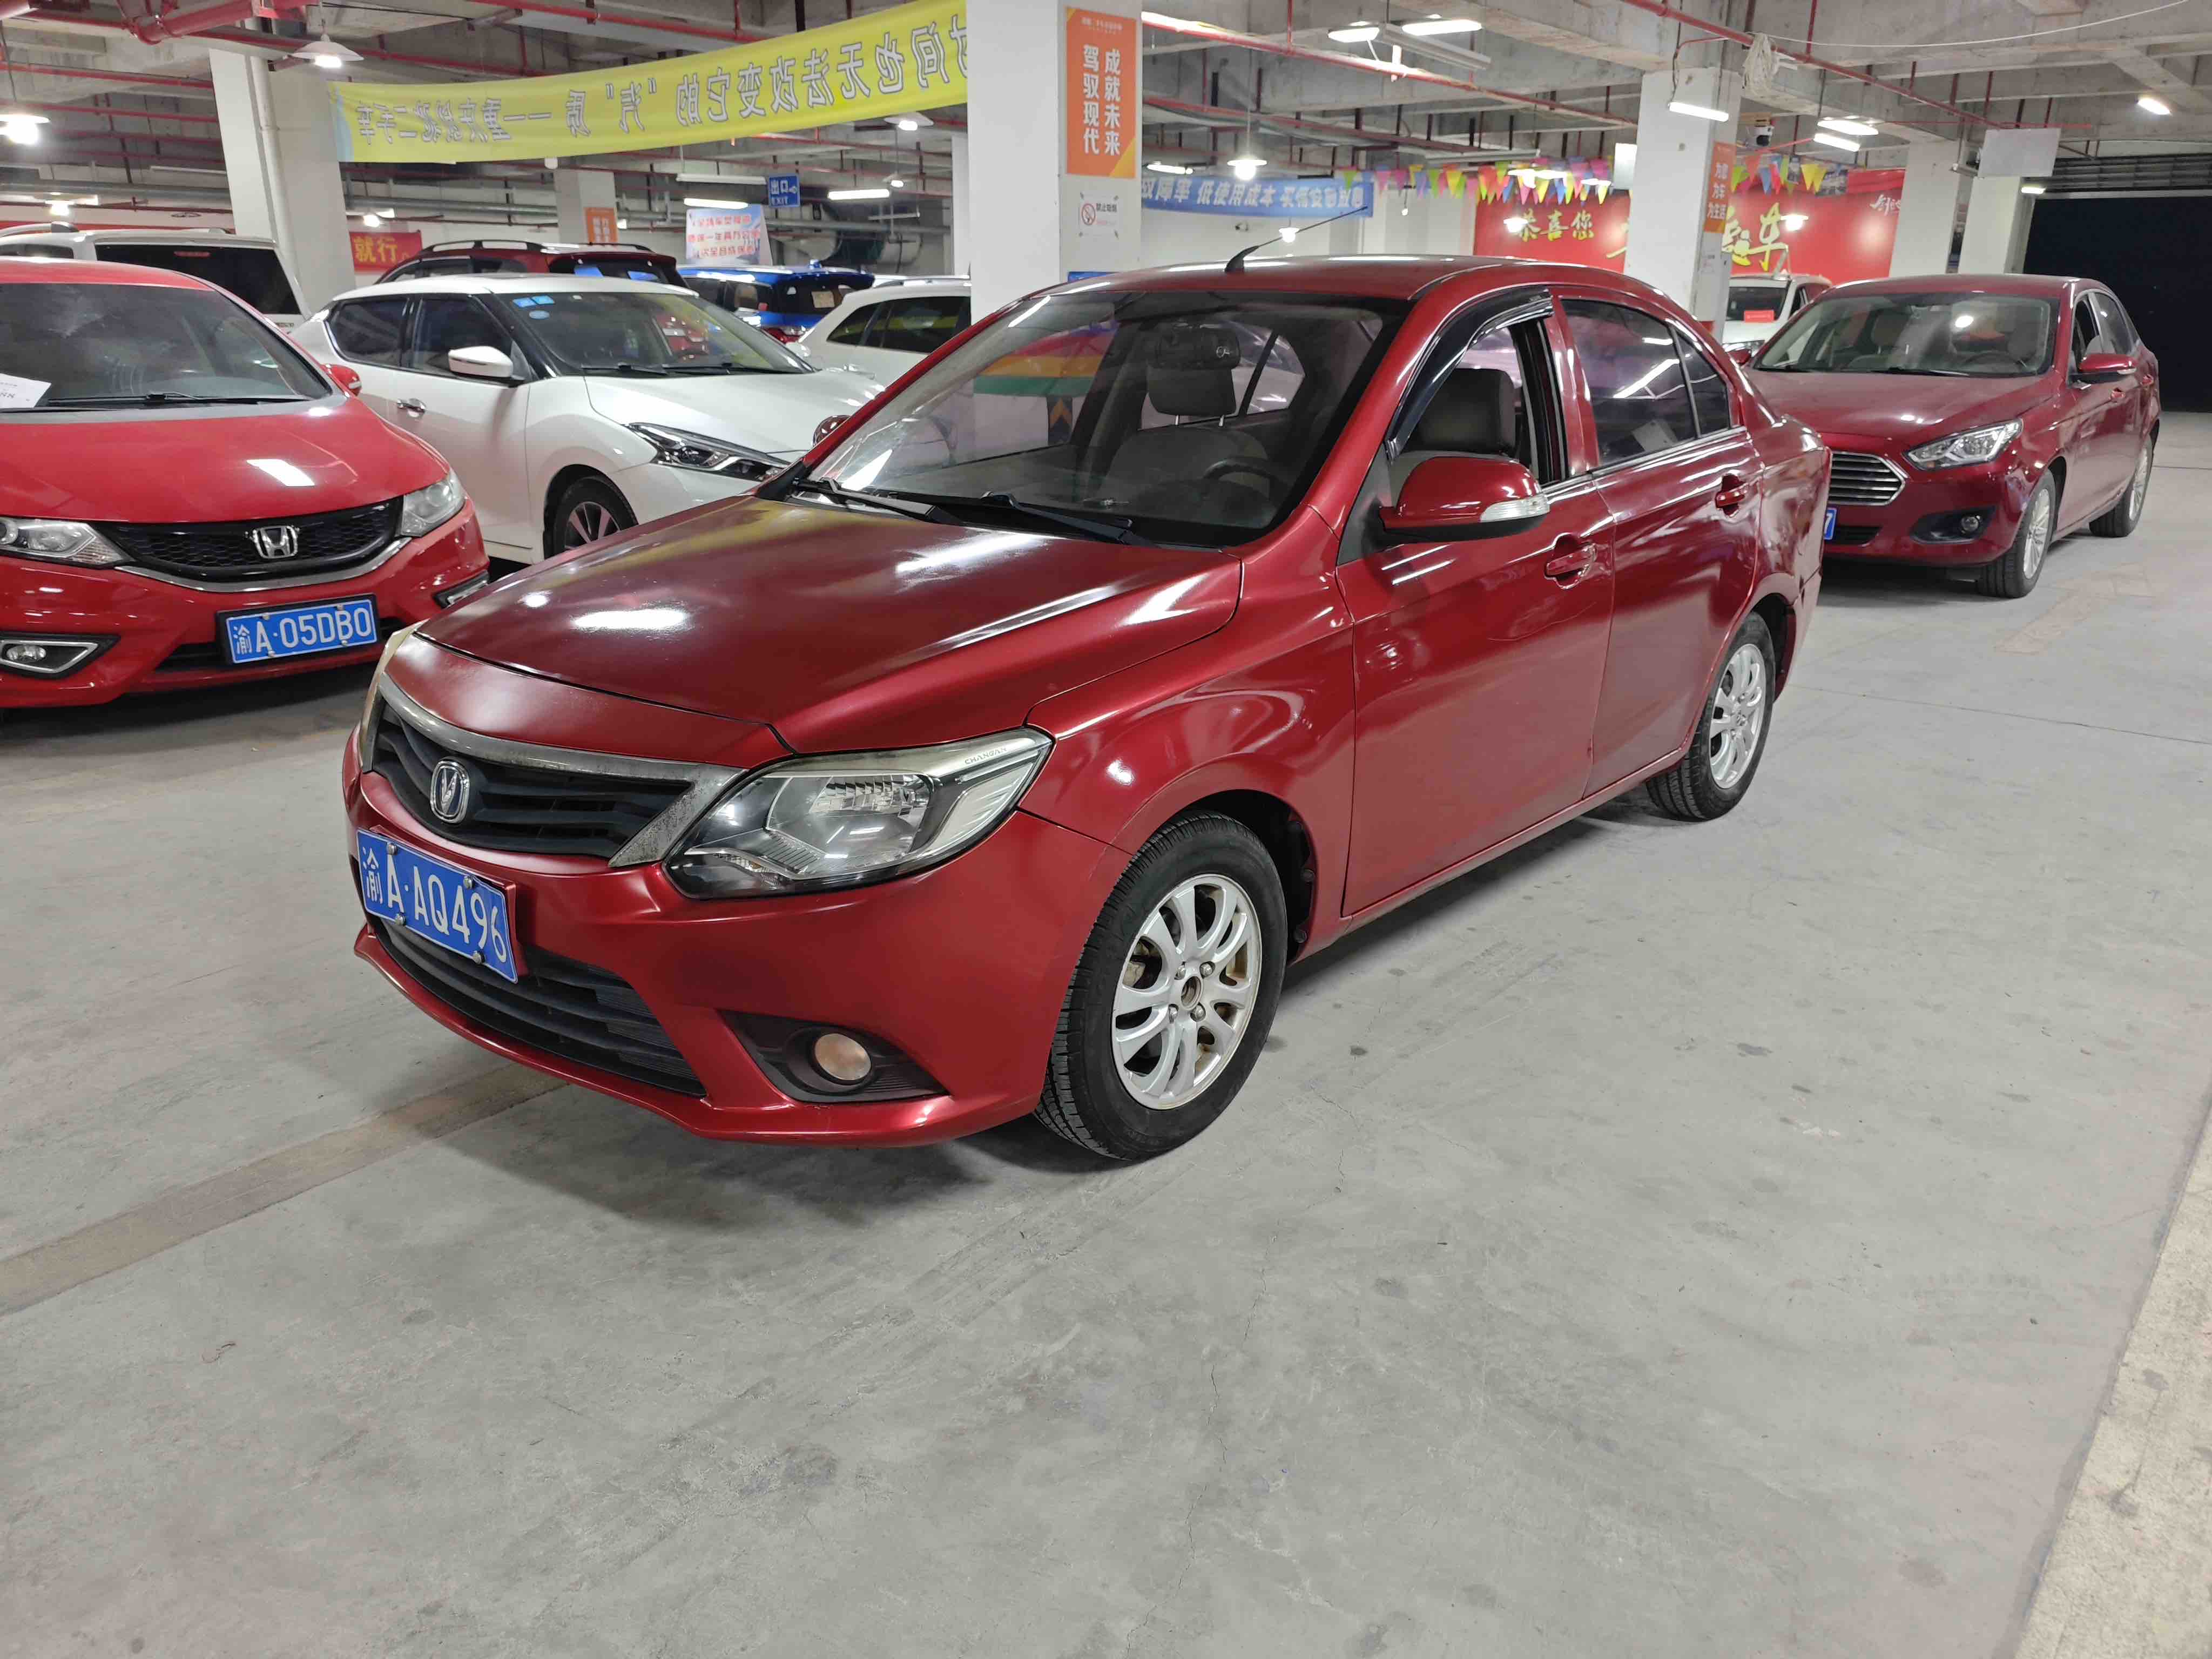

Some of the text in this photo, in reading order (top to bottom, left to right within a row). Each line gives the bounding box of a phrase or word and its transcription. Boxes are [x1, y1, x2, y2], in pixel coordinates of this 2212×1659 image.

[1082, 44, 1100, 155] 驾驭现代
[1104, 48, 1121, 156] 成就未来
[771, 180, 789, 194] 出口
[772, 197, 788, 205] EXIT
[1196, 180, 1276, 207] 低使用成本
[1519, 208, 1595, 242] 恭喜您
[362, 846, 507, 963] 渝A·AQ496
